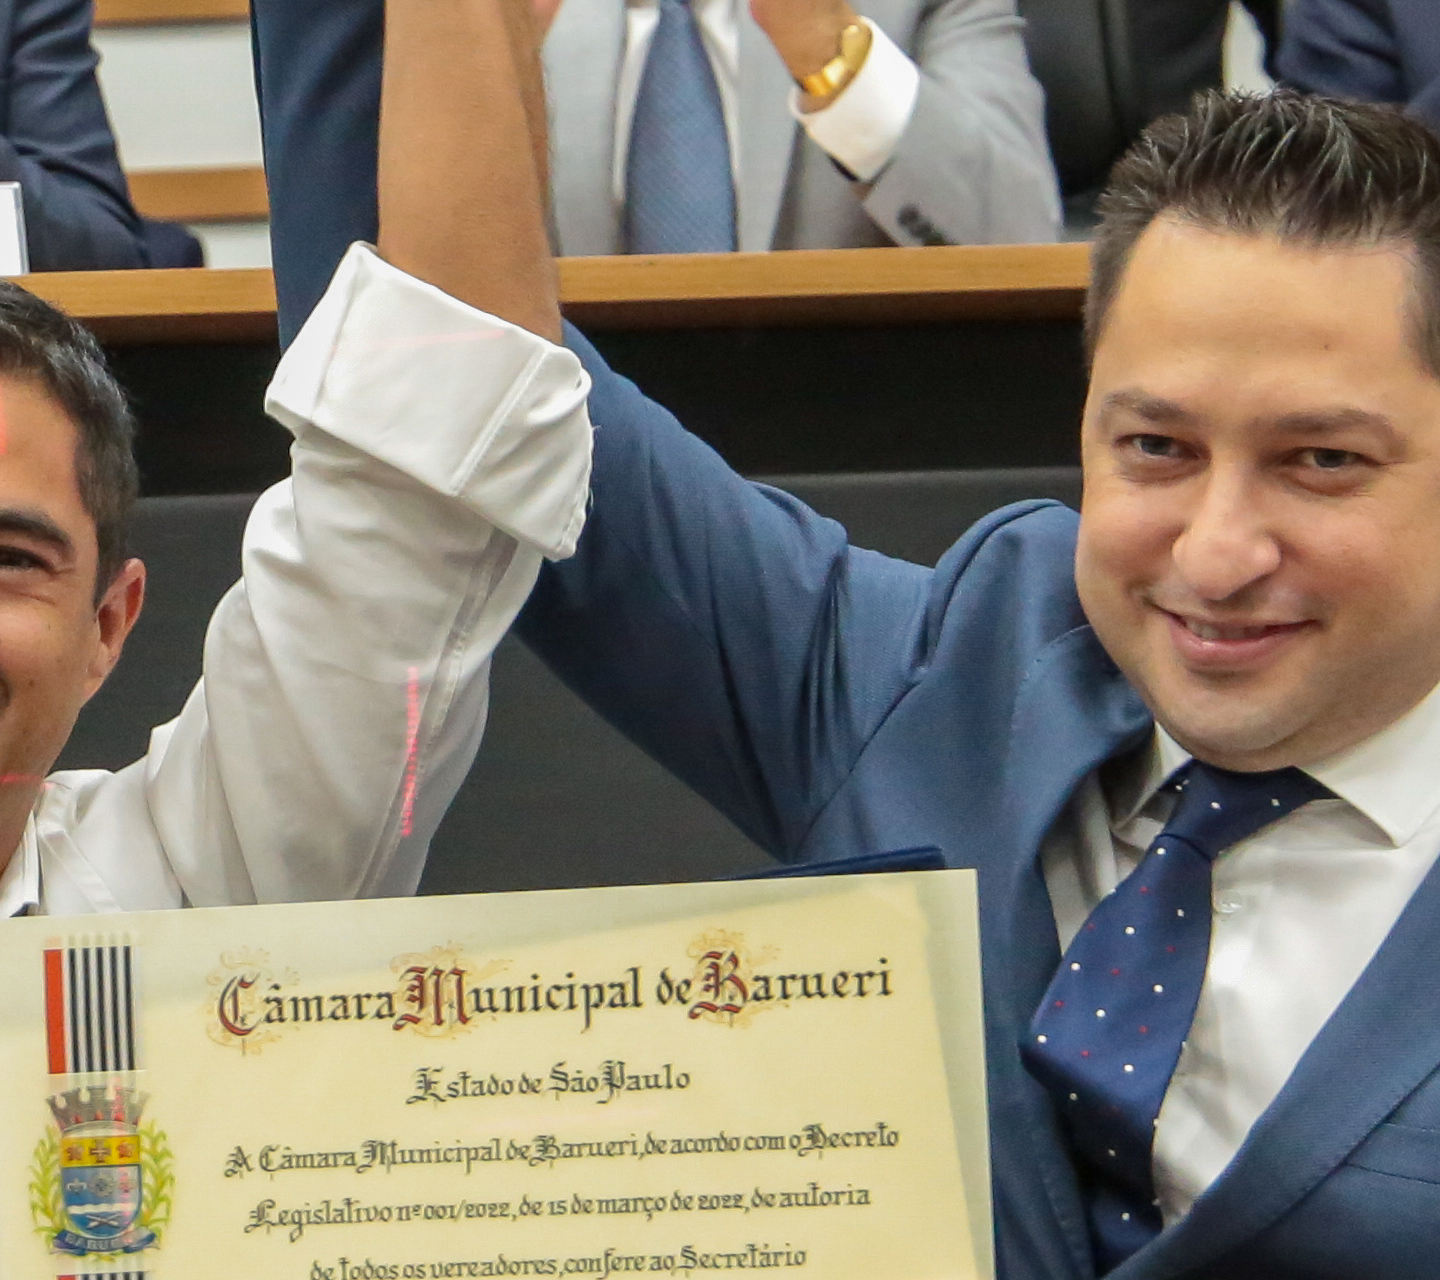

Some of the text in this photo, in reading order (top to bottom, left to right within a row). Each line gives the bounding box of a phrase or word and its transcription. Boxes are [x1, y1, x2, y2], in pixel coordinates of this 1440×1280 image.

[219, 951, 894, 1038] Câmara Municipal de Barueri
[406, 1060, 691, 1106] Estado de São Paulo
[224, 1145, 255, 1178] A
[259, 1144, 357, 1175] Câmara
[356, 1138, 503, 1174] Municipal
[506, 1139, 531, 1161] de
[644, 1131, 668, 1155] de
[670, 1131, 741, 1154] acordo
[744, 1136, 786, 1151] com
[789, 1133, 801, 1150] o
[797, 1122, 899, 1157] Decreto
[244, 1197, 392, 1243] Legislativo
[519, 1194, 543, 1216] de
[547, 1200, 568, 1216] 15
[571, 1193, 594, 1215] de
[596, 1196, 667, 1221] março
[670, 1189, 694, 1210] de
[751, 1186, 775, 1208] de
[778, 1182, 871, 1208] autoria
[402, 1261, 427, 1280] os
[563, 1248, 645, 1280] confere
[649, 1256, 675, 1272] ao
[677, 1243, 807, 1273] Secretário
